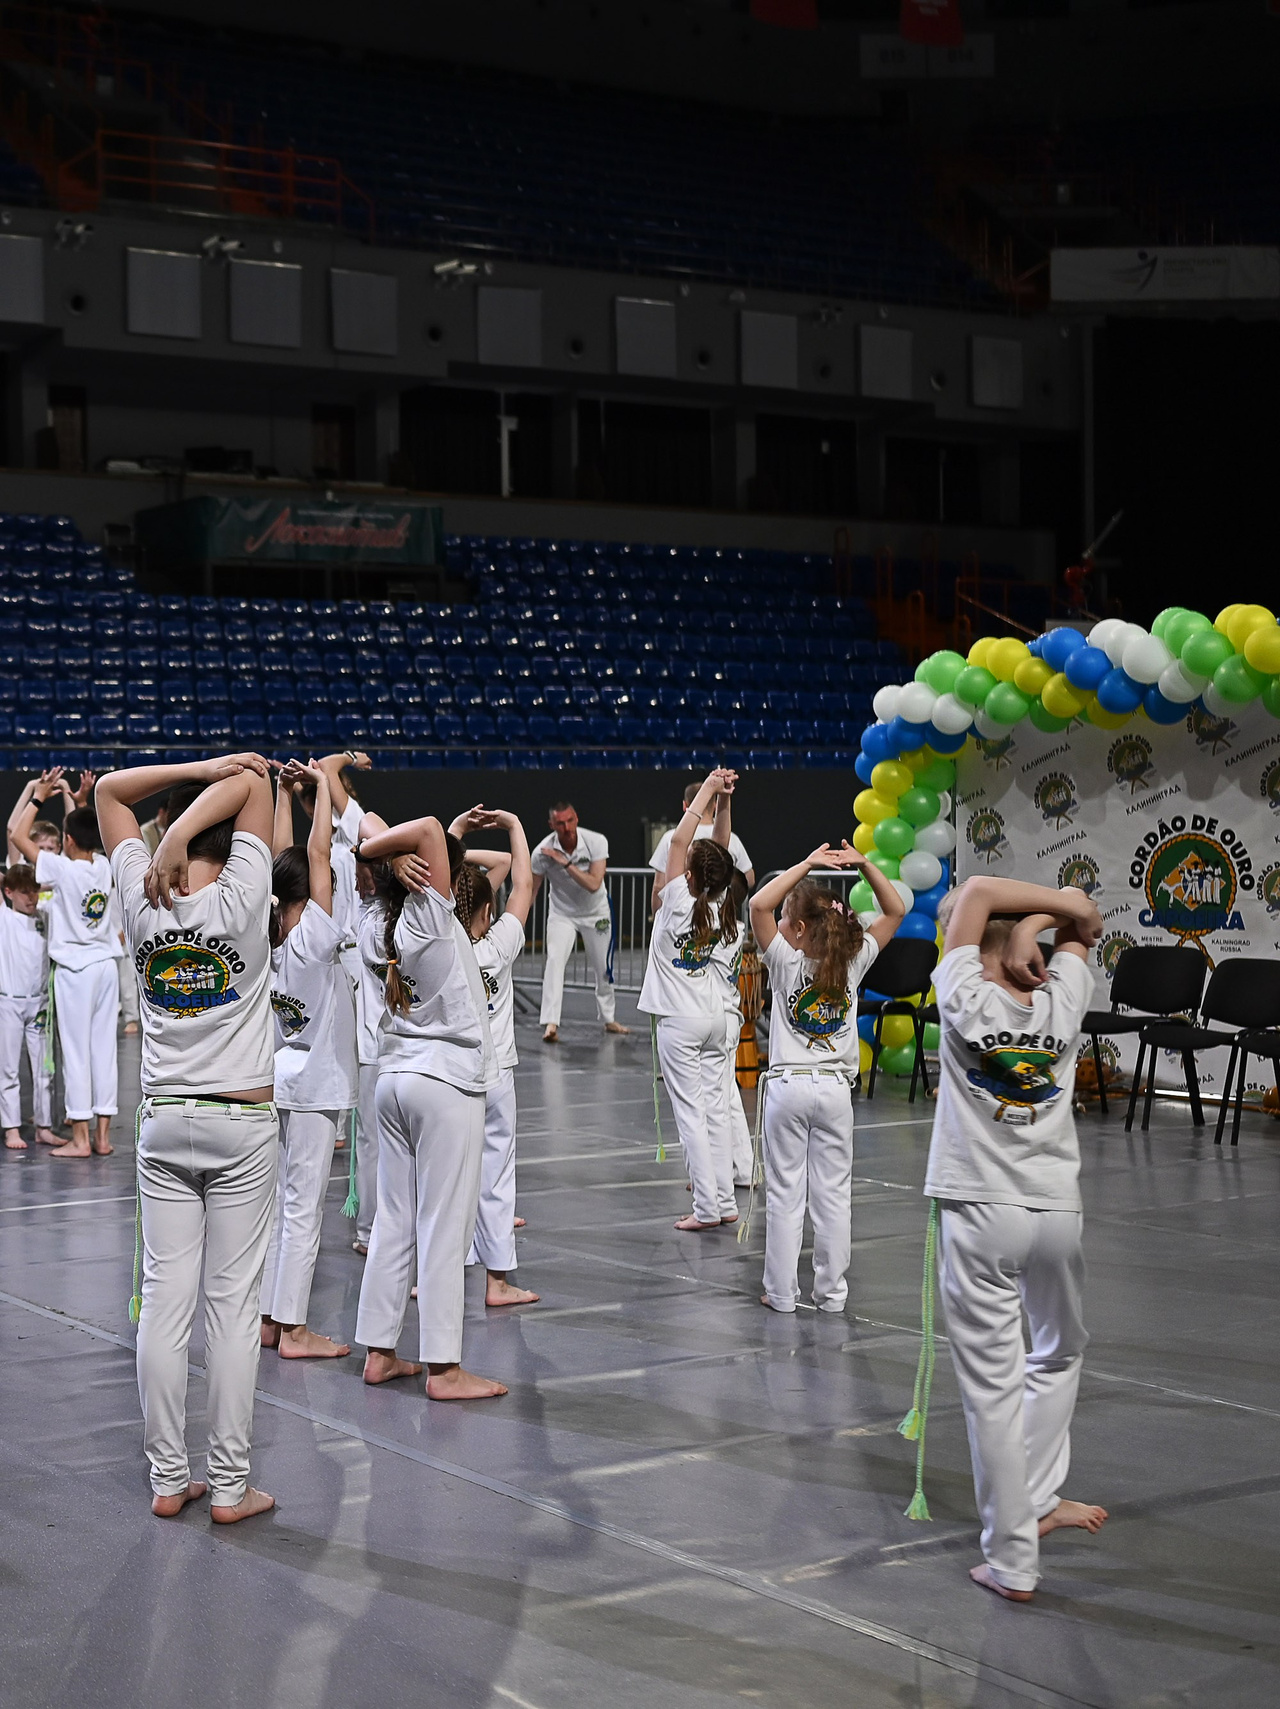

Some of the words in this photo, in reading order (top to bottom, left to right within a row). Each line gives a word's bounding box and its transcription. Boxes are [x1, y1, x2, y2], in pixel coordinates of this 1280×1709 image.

[1021, 742, 1071, 773] КАЛИНИНГРАД
[1125, 783, 1182, 816] КАЛИНИНГРАД
[1036, 830, 1088, 860] КАЛИНИНГРАД
[1128, 816, 1187, 890] CORDÃO
[1191, 814, 1219, 835] DE
[1220, 828, 1255, 892] OURO
[1138, 908, 1246, 931] CAPOEIRA
[1111, 930, 1121, 939] DE
[1123, 931, 1138, 947] OUR
[1211, 938, 1251, 946] KALININGRAD
[135, 931, 179, 975] CORDÃO
[183, 930, 203, 946] DE
[206, 937, 246, 975] OURO
[483, 971, 499, 995] OURO
[280, 994, 306, 1010] OURO
[1016, 1033, 1041, 1048] DE
[1247, 1082, 1258, 1090] DE
